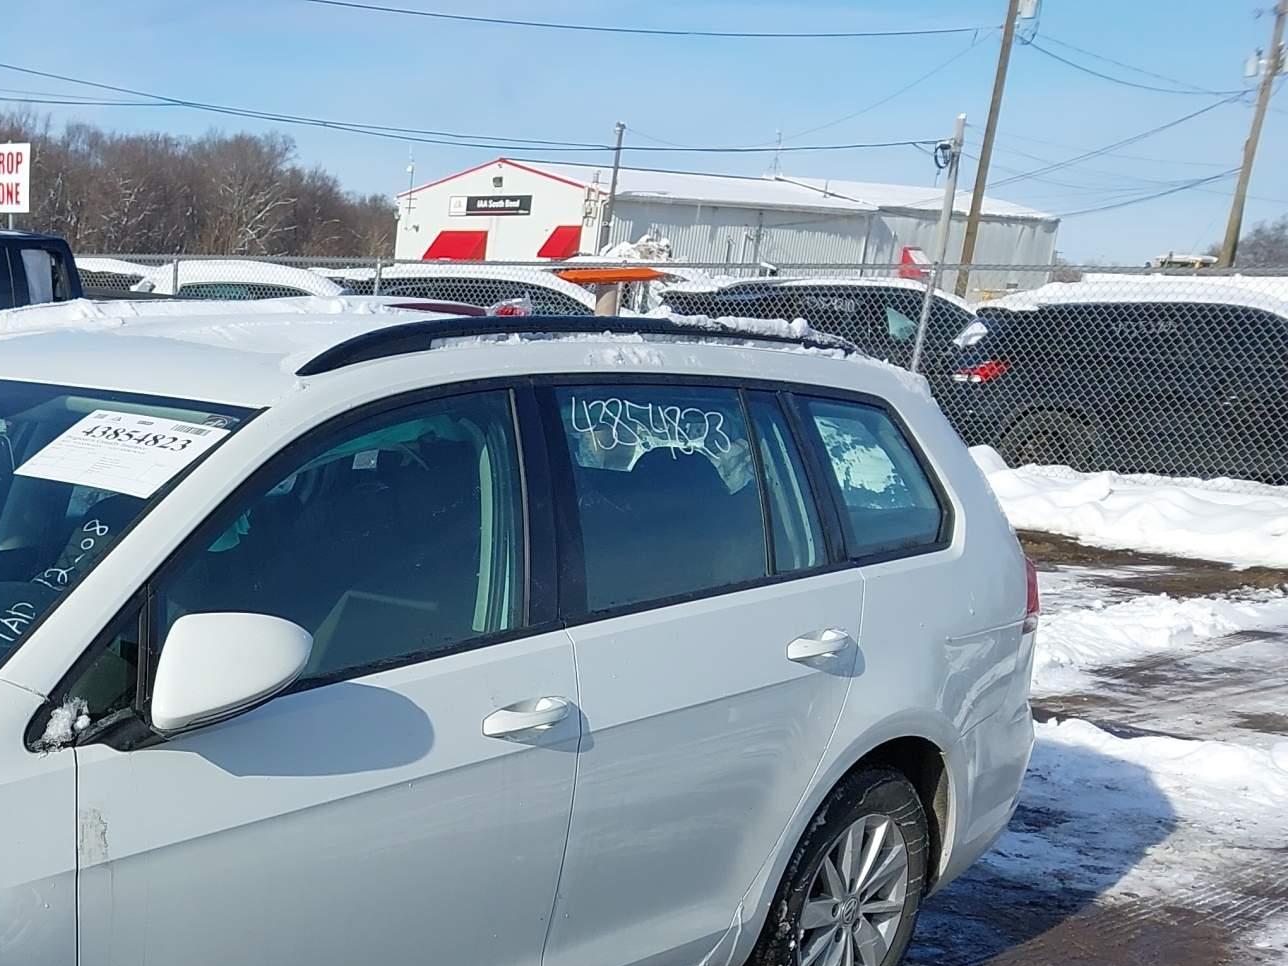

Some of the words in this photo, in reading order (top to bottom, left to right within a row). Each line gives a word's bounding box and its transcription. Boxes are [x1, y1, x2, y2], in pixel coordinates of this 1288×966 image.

[82, 424, 193, 451] 43854823
[571, 396, 732, 460] 43854823
[30, 518, 110, 592] 12-08
